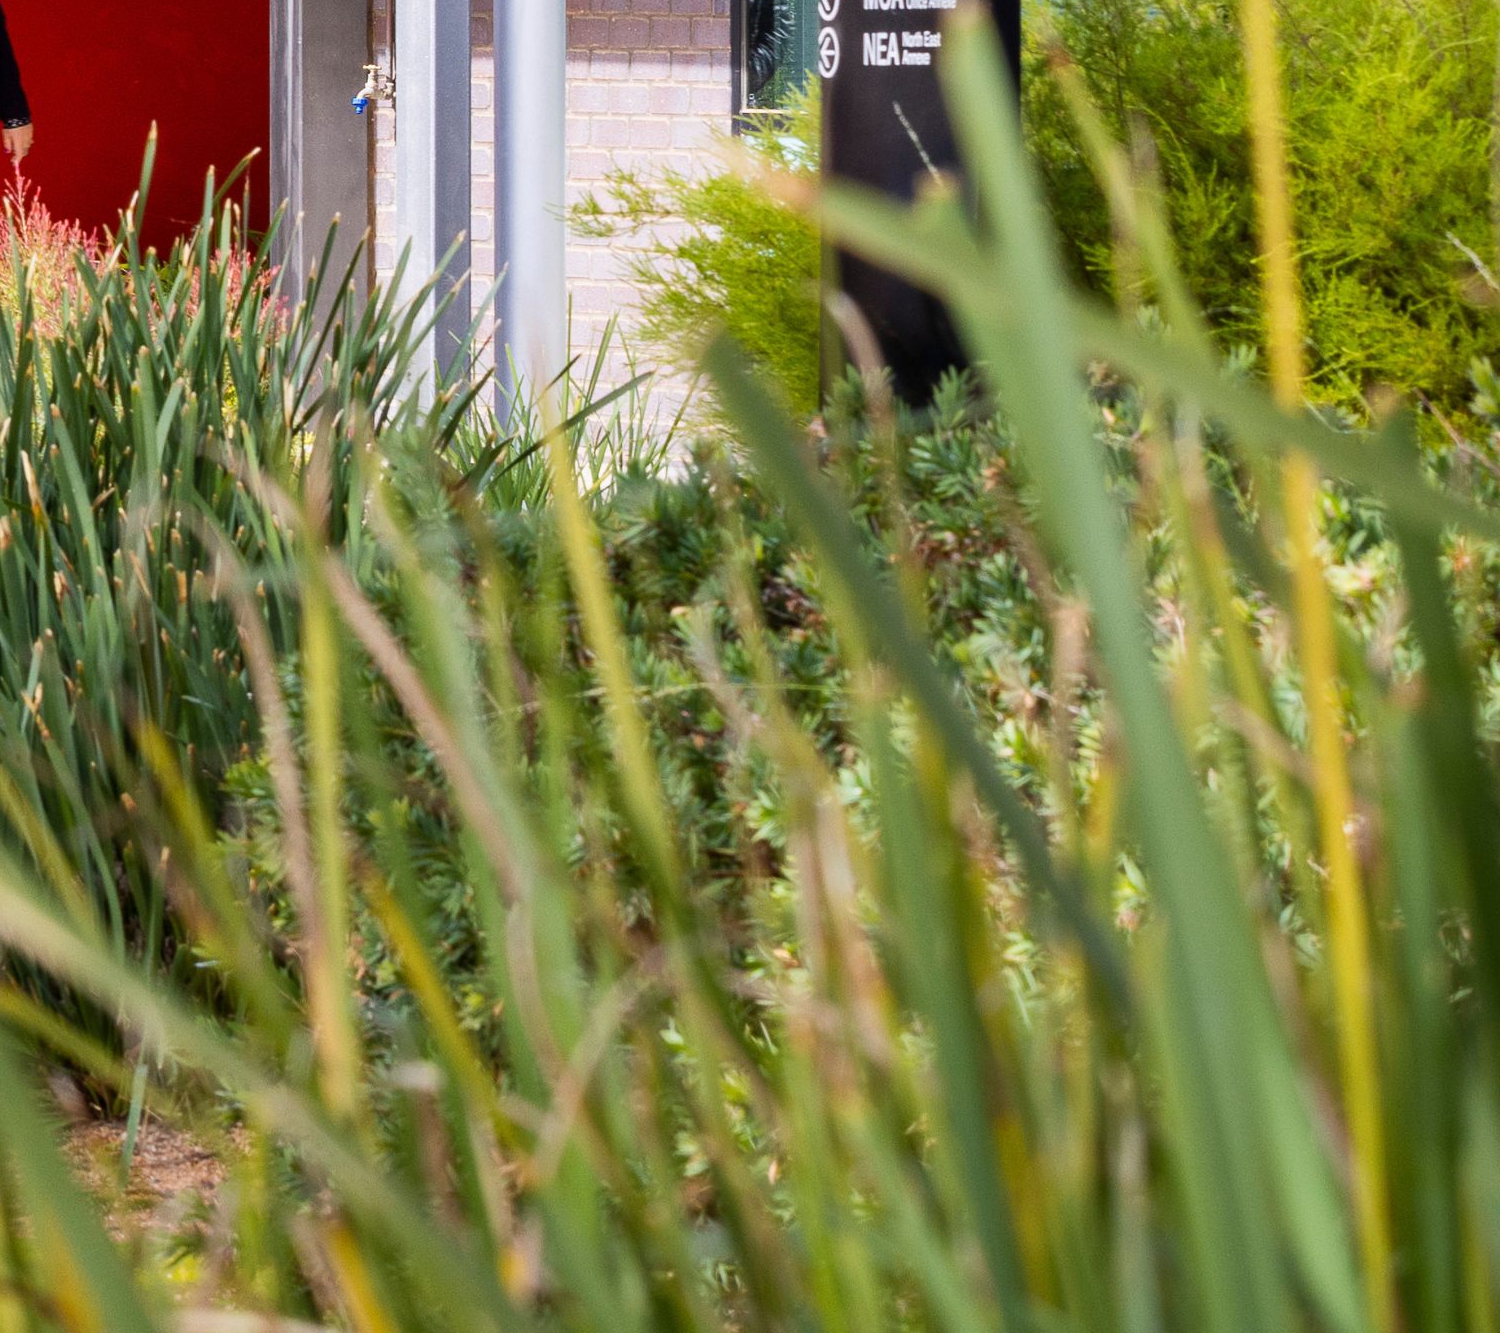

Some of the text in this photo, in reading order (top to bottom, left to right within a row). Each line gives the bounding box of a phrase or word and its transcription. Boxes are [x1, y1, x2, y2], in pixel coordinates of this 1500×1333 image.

[862, 31, 901, 66] NEA
[901, 30, 942, 47] North East
